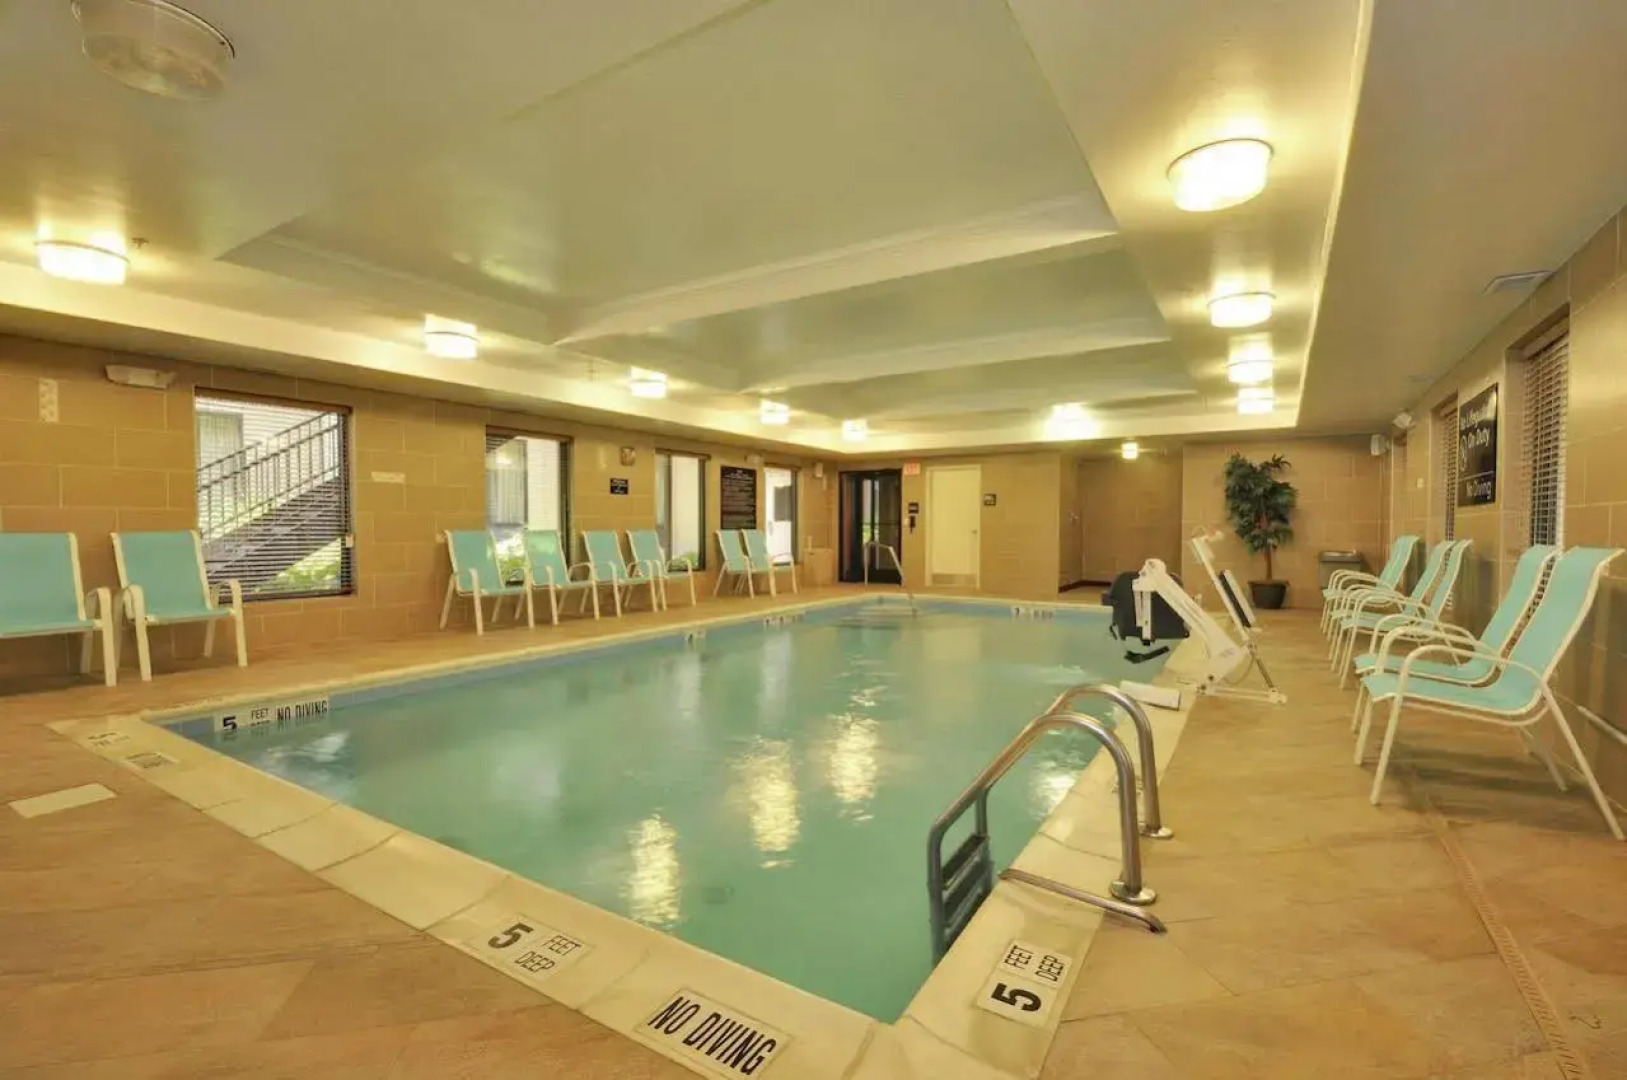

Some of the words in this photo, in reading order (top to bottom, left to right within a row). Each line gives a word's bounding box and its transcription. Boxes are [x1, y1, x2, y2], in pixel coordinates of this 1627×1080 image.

[222, 715, 237, 730] 5
[251, 708, 270, 720] FEET
[277, 706, 291, 721] NO
[295, 700, 328, 718] DIVING
[488, 922, 534, 949] 5
[540, 934, 582, 956] FEET
[514, 950, 556, 974] DEEP
[1004, 945, 1034, 970] FEET
[1034, 955, 1064, 982] DEEP
[991, 982, 1042, 1012] 5
[648, 996, 700, 1035] NO
[682, 1012, 776, 1076] DIVING
